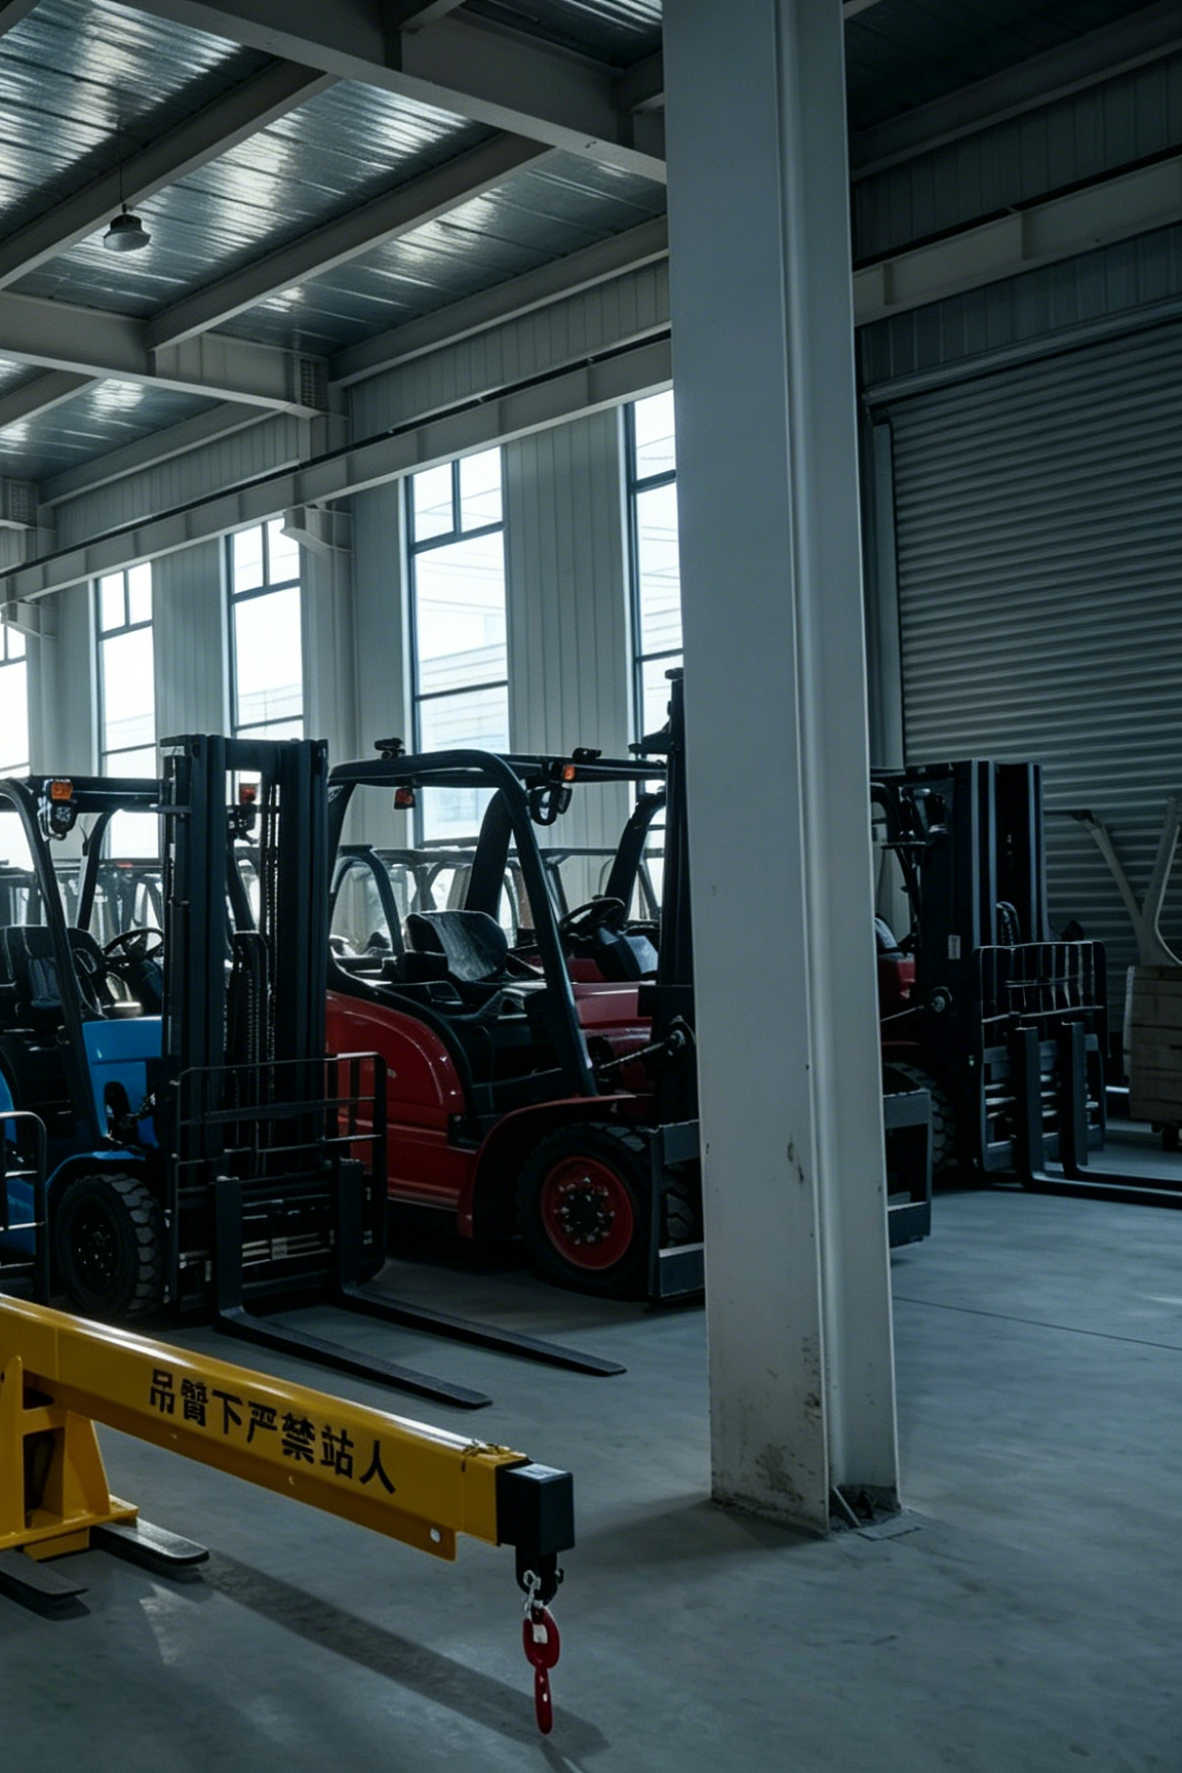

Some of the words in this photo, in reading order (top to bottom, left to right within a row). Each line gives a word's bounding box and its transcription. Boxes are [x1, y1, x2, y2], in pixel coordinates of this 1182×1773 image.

[150, 1368, 396, 1494] 吊臂下严禁站人
